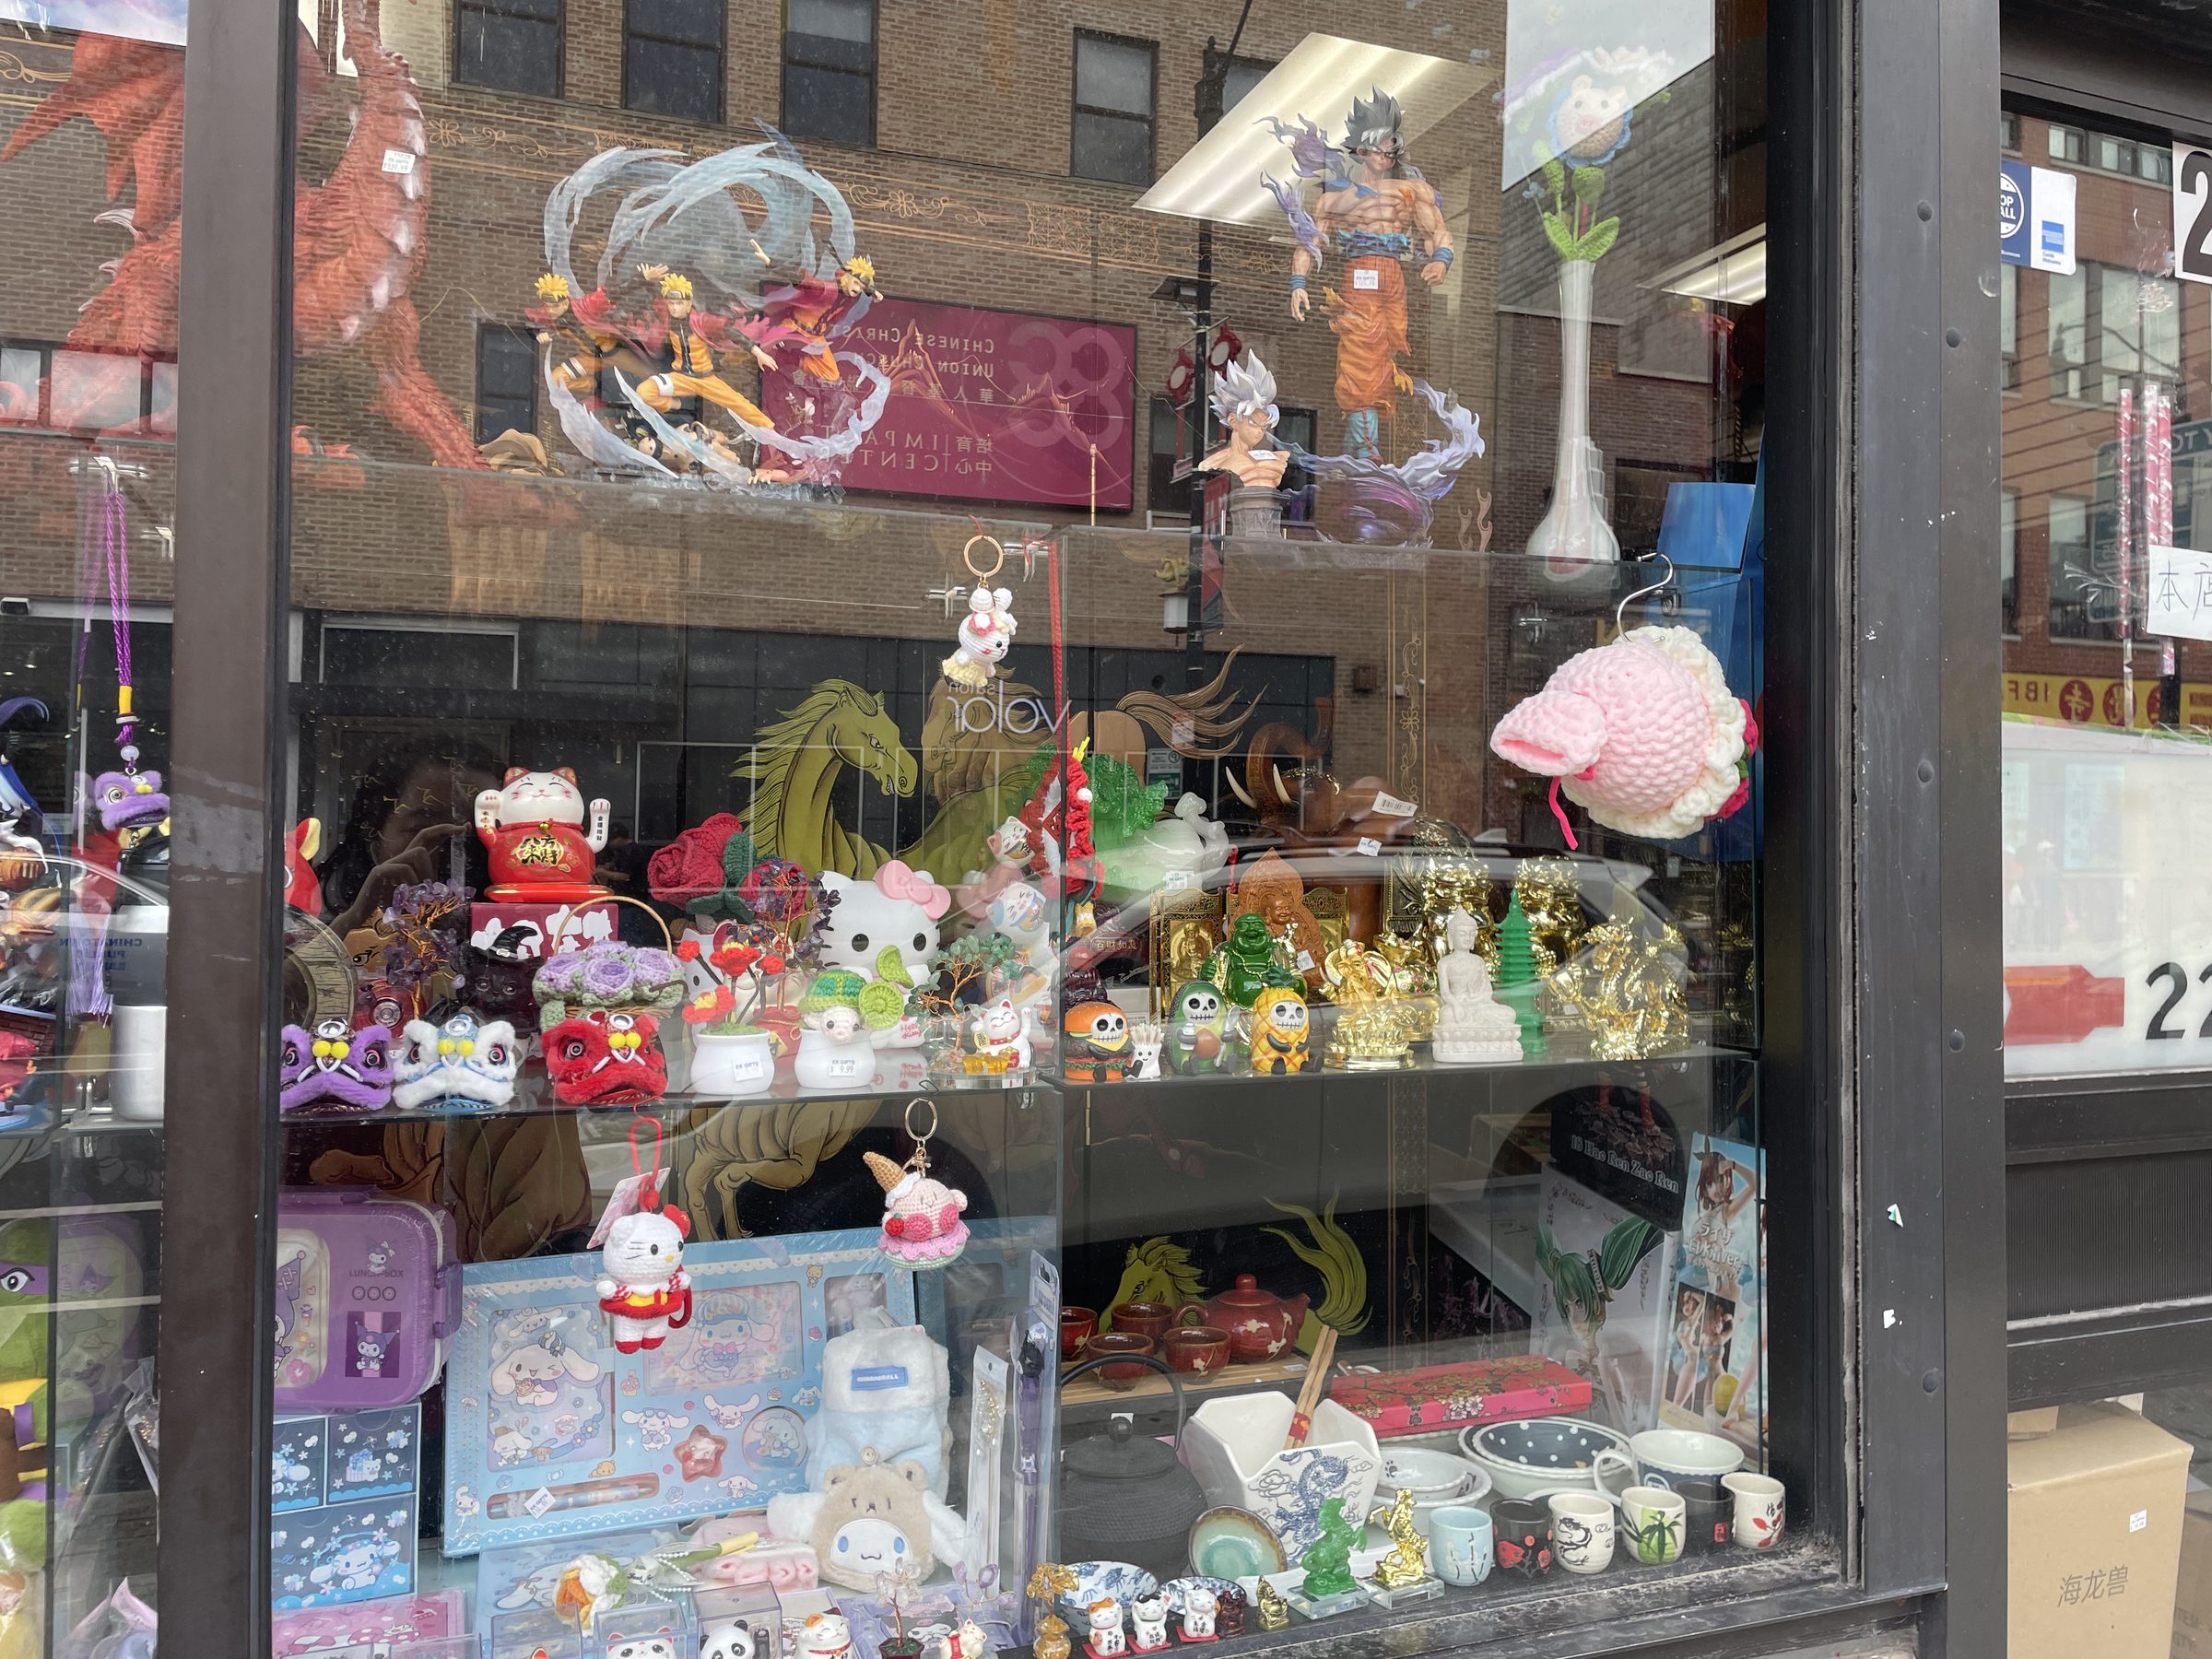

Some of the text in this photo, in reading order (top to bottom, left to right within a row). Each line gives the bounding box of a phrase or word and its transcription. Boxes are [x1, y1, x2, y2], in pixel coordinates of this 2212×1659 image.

[2001, 194, 2014, 207] OP
[2001, 207, 2016, 220] ALL
[1571, 1134, 1679, 1194] 18 Hao Ren Zao Ren
[2056, 1564, 2129, 1607] 海龙兽
